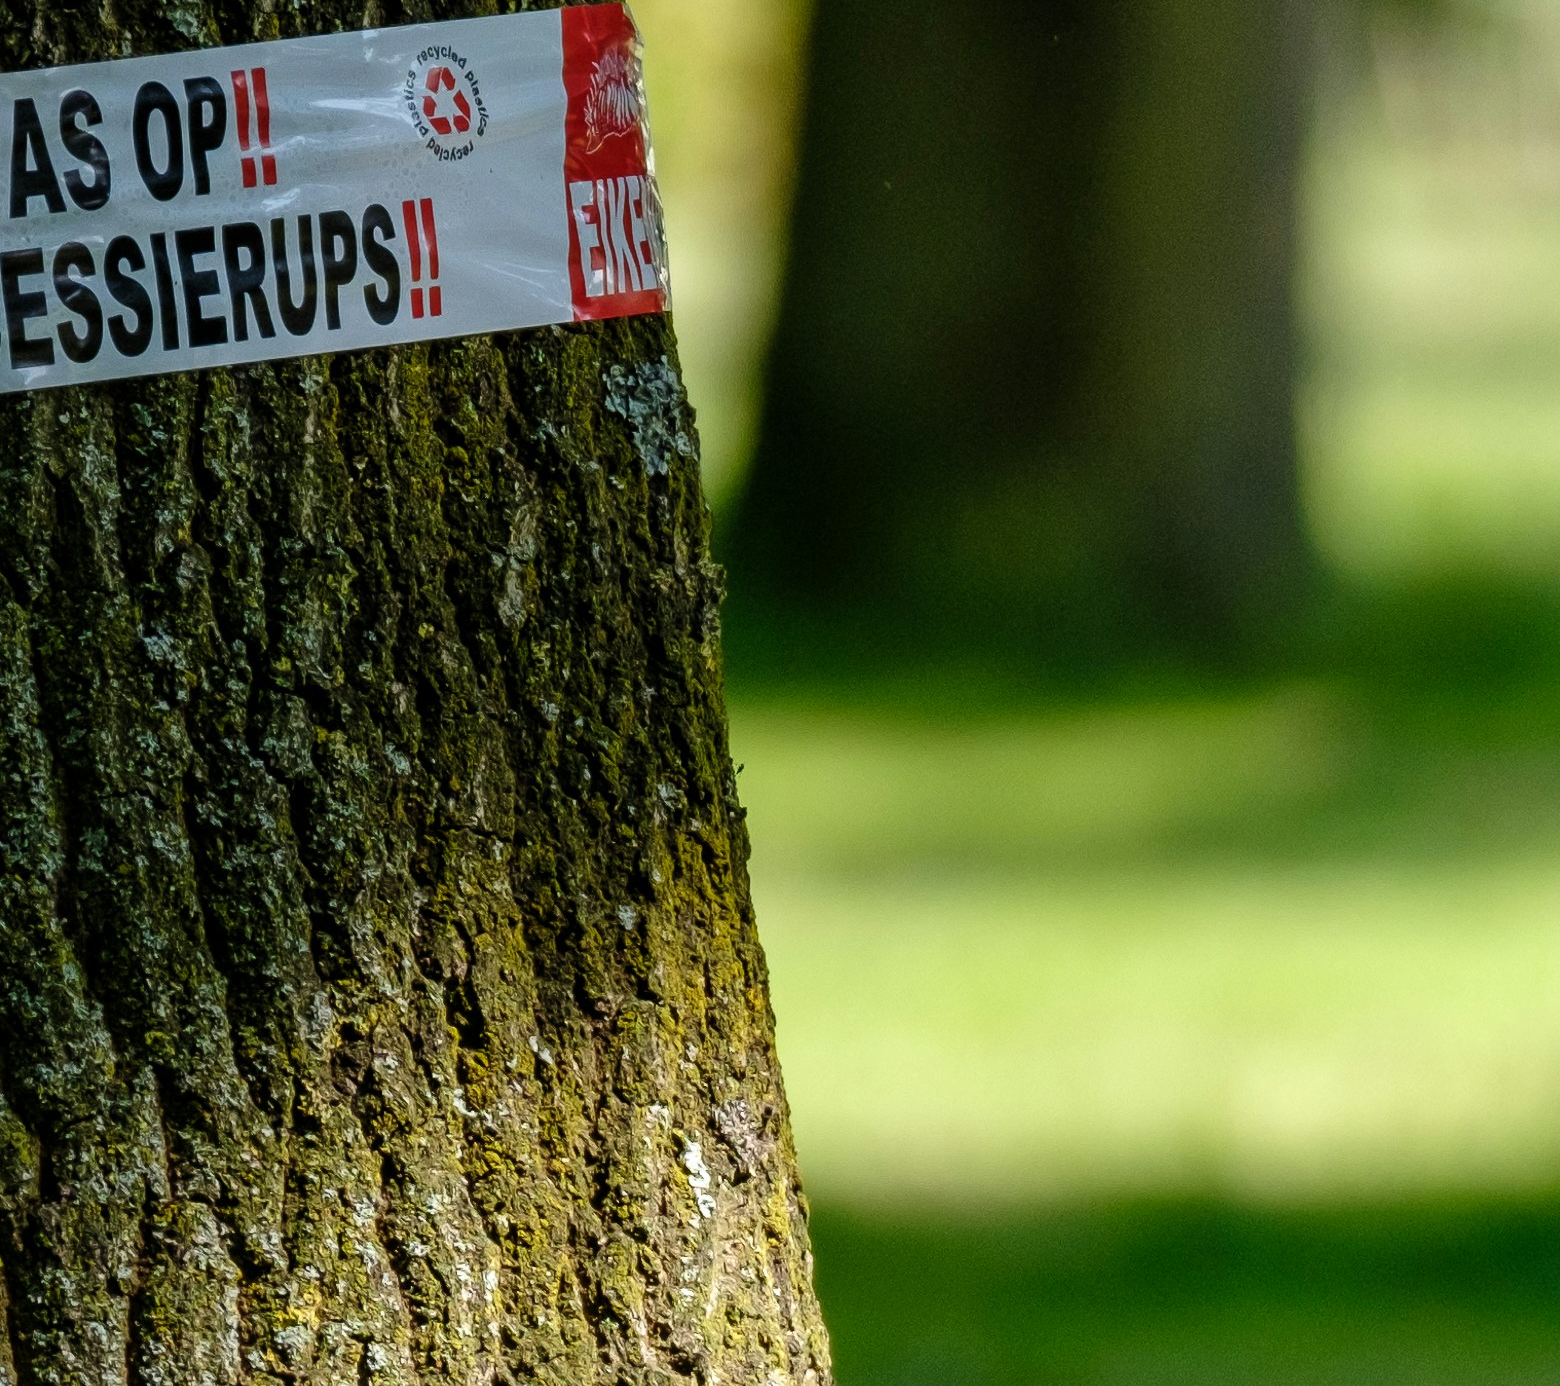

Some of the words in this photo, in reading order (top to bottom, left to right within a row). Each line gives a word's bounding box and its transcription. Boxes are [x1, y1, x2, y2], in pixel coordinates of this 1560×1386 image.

[404, 69, 429, 138] plastics
[417, 45, 467, 70] recycled
[464, 69, 490, 137] plastics
[132, 66, 278, 202] OP!!
[426, 137, 475, 162] recycled
